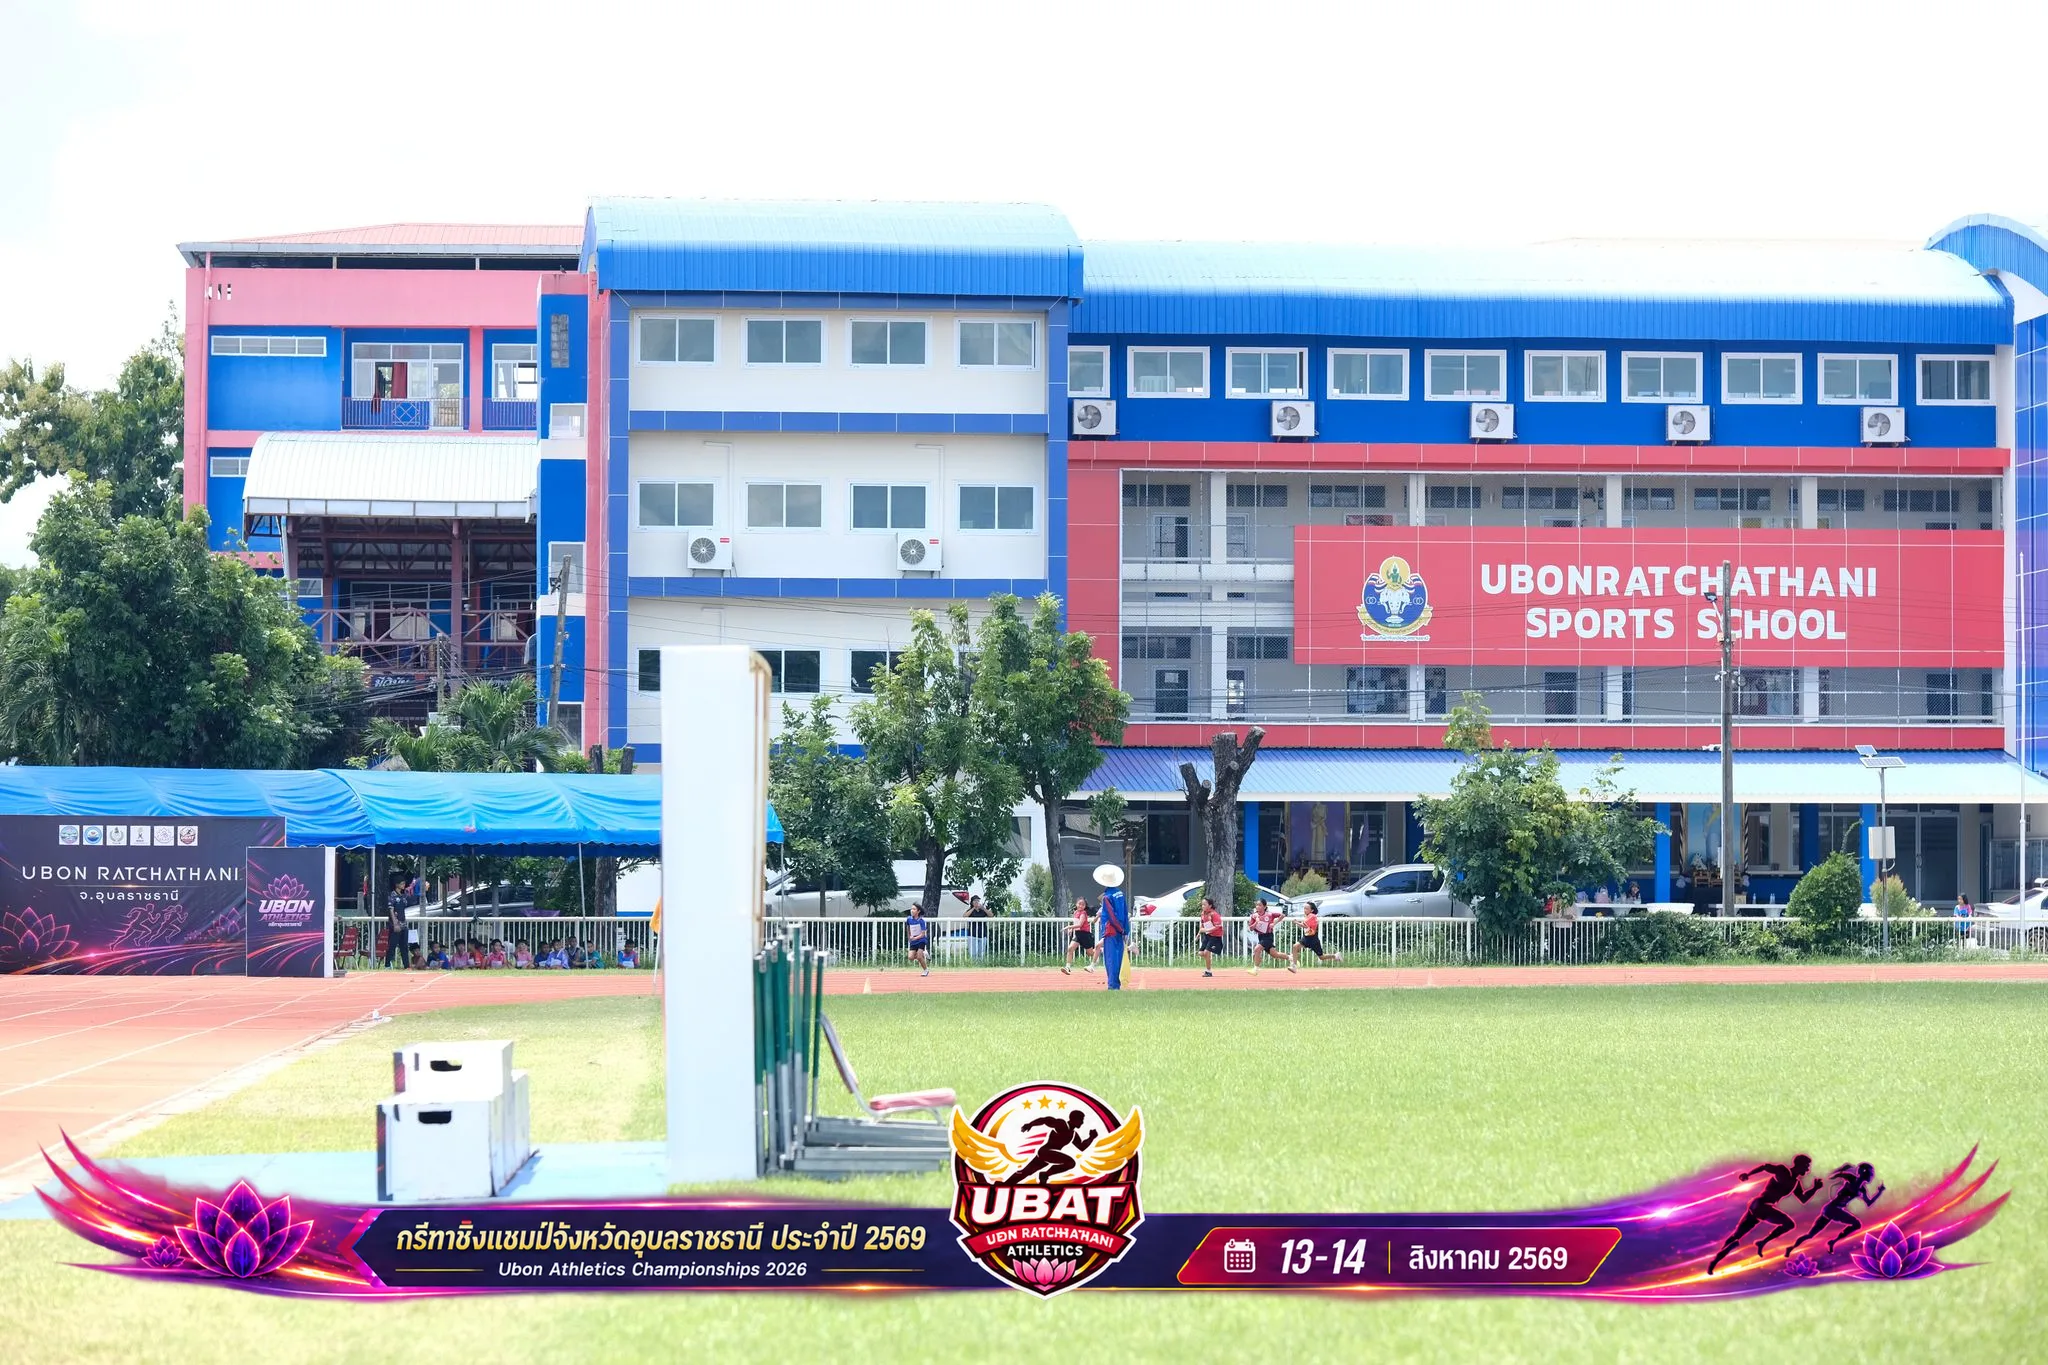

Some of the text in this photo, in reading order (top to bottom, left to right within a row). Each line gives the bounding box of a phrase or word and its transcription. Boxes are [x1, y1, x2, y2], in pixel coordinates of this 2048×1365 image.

[1481, 564, 1877, 597] UBONRATCHATHANI
[1526, 607, 1846, 640] SPORTS SCHOOL
[22, 866, 239, 881] UBON RATCHATHANI
[79, 889, 179, 903] จ.อุบลราชธานี
[258, 899, 315, 913] UBON
[260, 913, 312, 921] ATHLETICS
